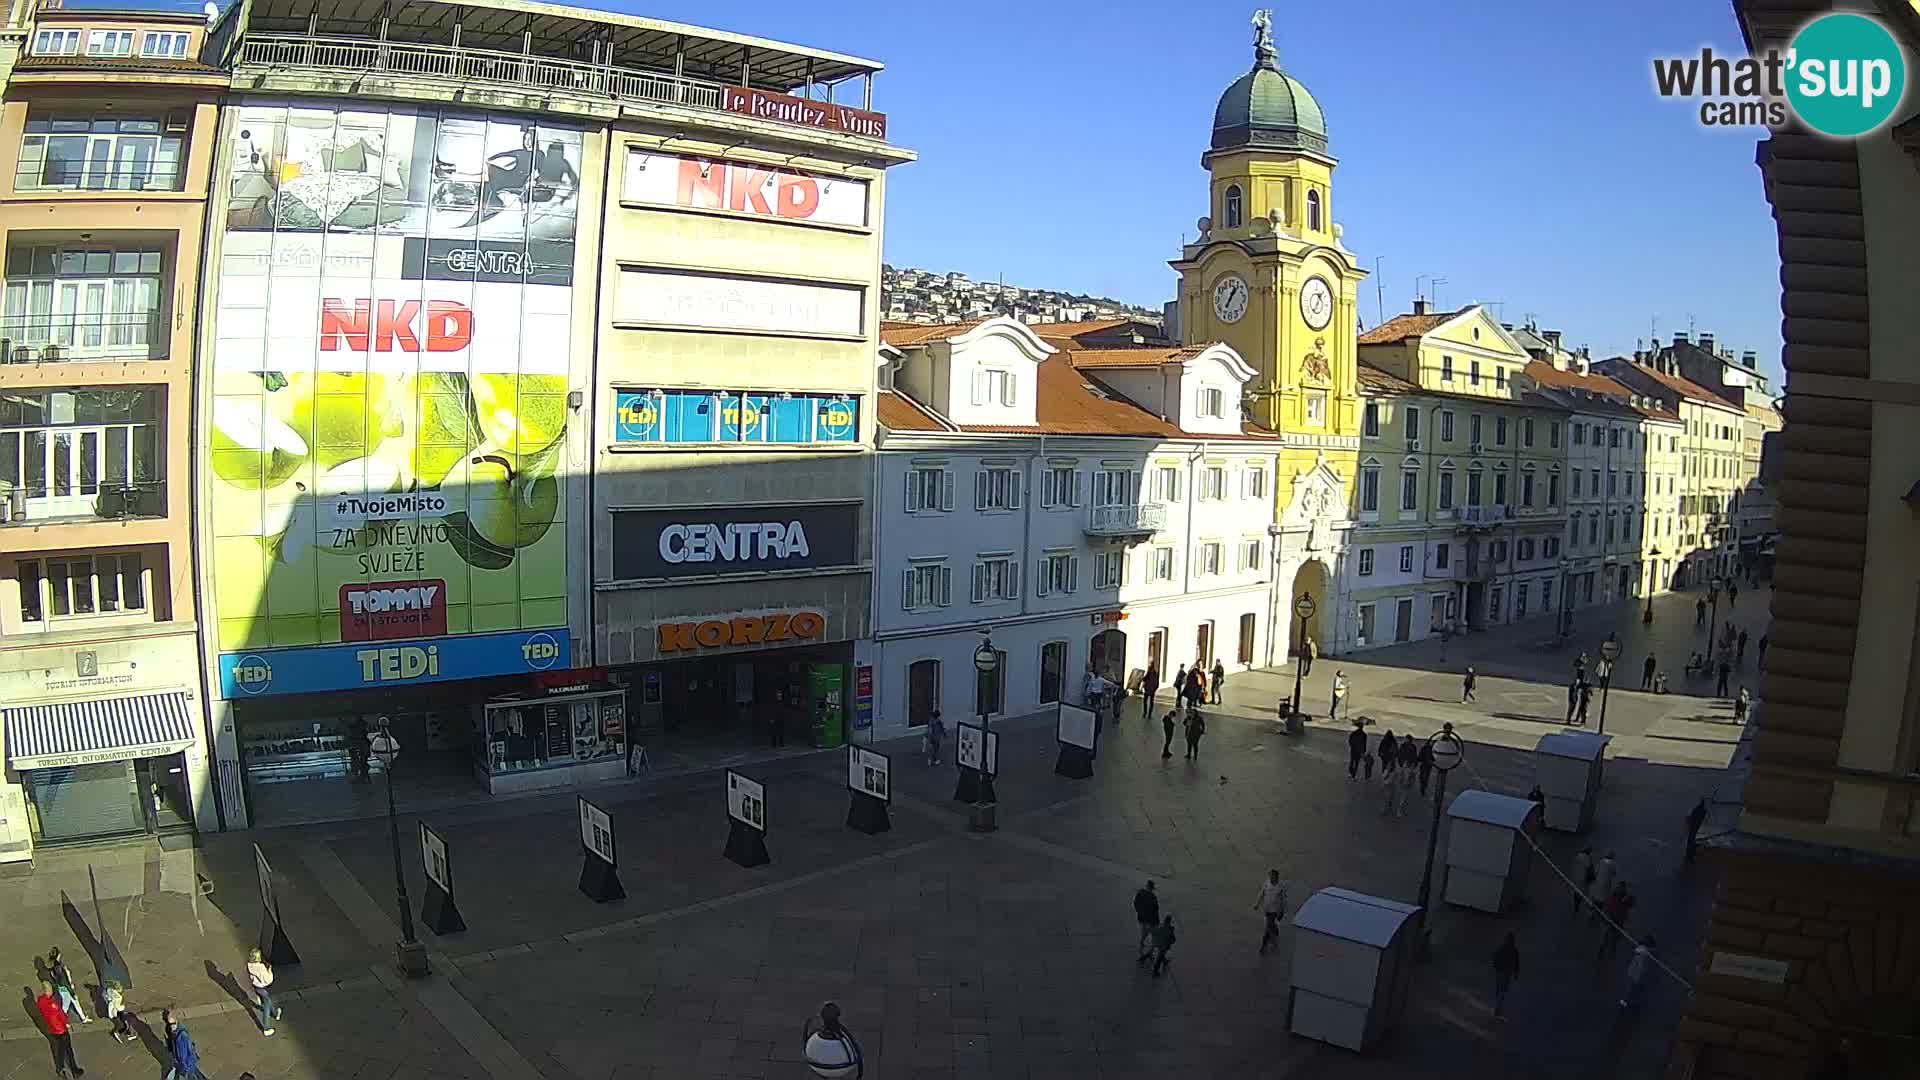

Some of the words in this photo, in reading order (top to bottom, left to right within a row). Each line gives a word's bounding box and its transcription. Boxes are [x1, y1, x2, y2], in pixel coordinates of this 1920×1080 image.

[722, 87, 745, 112] Le
[677, 160, 819, 218] NKD
[447, 250, 534, 275] CENTRA
[320, 297, 476, 352] NKD
[618, 408, 657, 425] TEDi
[337, 496, 445, 516] #TvojeMisto
[332, 528, 356, 549] ZA
[366, 523, 449, 548] DNEVNO
[658, 520, 810, 564] CENTRA
[358, 547, 425, 575] SVJEŽE
[348, 585, 439, 614] TOMMY
[658, 612, 825, 652] KORZO
[357, 644, 438, 682] TEDi
[521, 642, 560, 660] TEDi
[232, 665, 272, 683] TEDi
